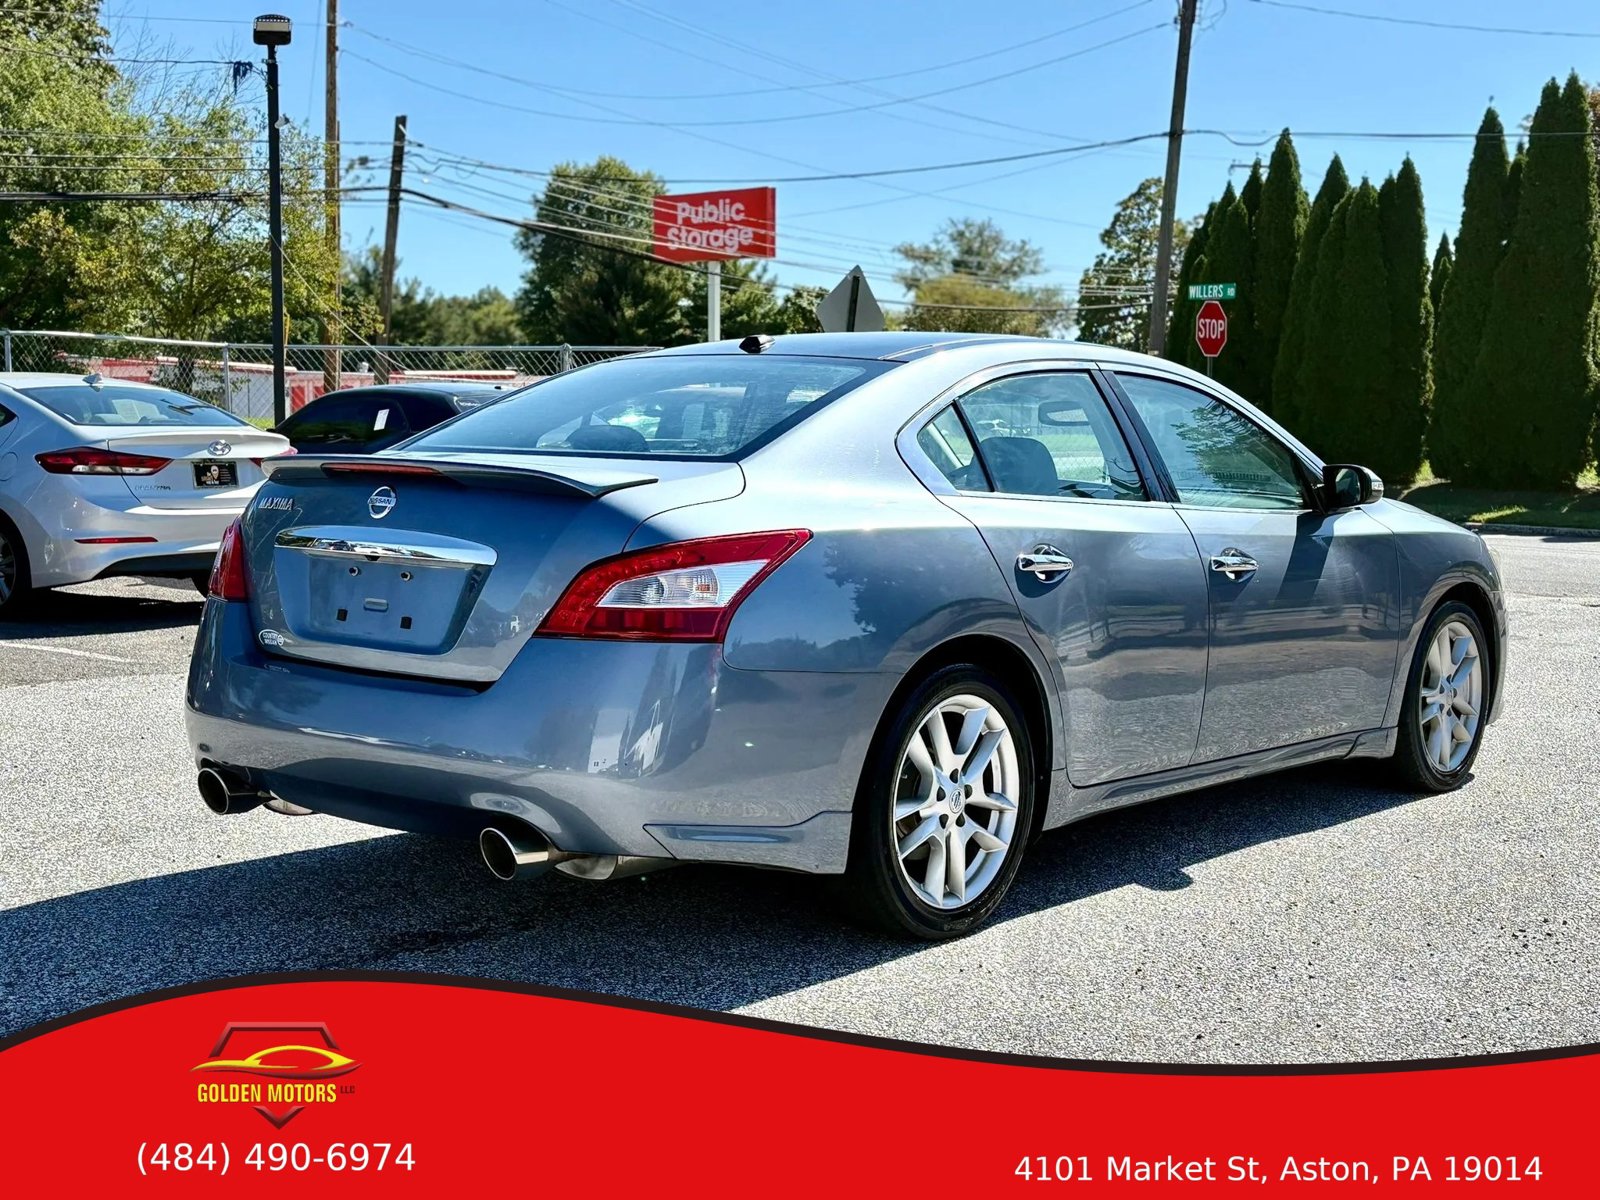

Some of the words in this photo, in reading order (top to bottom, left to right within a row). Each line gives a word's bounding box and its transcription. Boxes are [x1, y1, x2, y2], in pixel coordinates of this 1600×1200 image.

[676, 199, 745, 225] Public
[667, 227, 753, 254] Storage
[1189, 284, 1224, 299] WILLERS
[1198, 318, 1225, 339] STOP
[258, 497, 293, 511] MAXIMA
